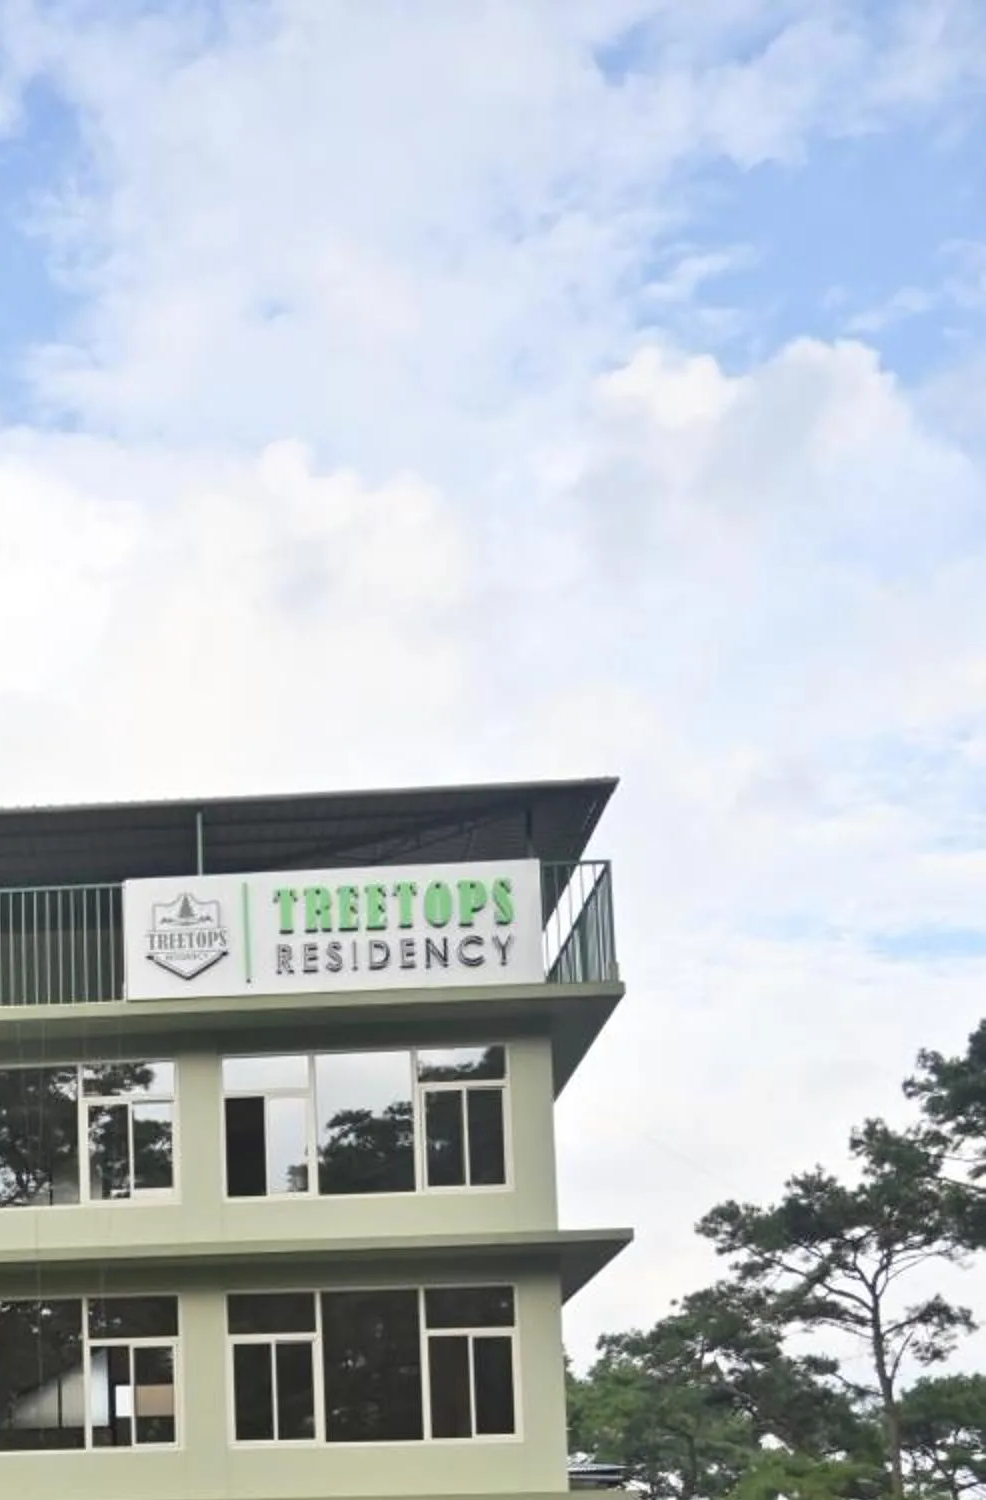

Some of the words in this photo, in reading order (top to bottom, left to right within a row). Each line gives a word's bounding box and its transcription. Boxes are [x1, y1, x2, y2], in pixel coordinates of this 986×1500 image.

[273, 878, 515, 934] TREETOPS
[148, 930, 227, 951] TREETOPS
[275, 934, 515, 976] RESIDENCY
